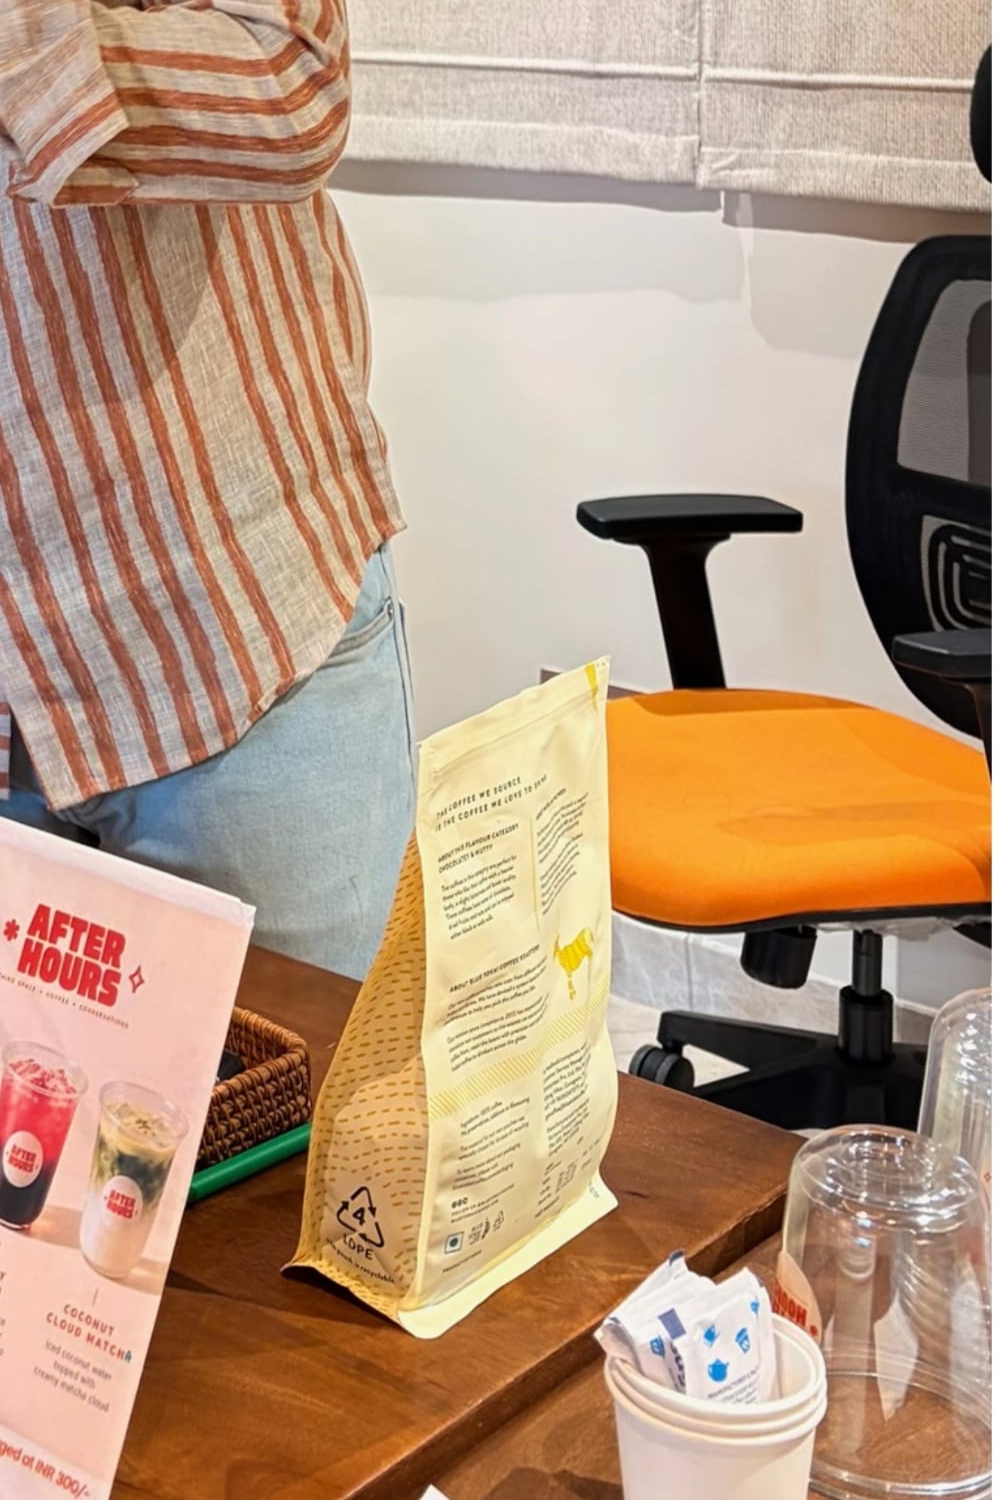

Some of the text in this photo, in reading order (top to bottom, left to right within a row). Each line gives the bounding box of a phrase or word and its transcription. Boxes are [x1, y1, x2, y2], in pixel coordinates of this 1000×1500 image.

[449, 794, 476, 811] COFFEE
[479, 788, 490, 799] WE
[494, 776, 521, 795] SOURCE
[458, 803, 488, 821] COFFEE
[491, 797, 502, 808] WE
[504, 790, 522, 804] LOVE
[491, 823, 519, 840] CATEGORY
[27, 903, 126, 969] AFTER
[17, 938, 122, 1007] HOURS
[352, 1207, 366, 1226] 4
[46, 1312, 82, 1337] CLOUD
[64, 1304, 114, 1337] COCONUT
[91, 1365, 112, 1381] water
[33, 1366, 110, 1413] creamy matcha cloud
[21, 1454, 35, 1469] at
[34, 1459, 56, 1480] INR
